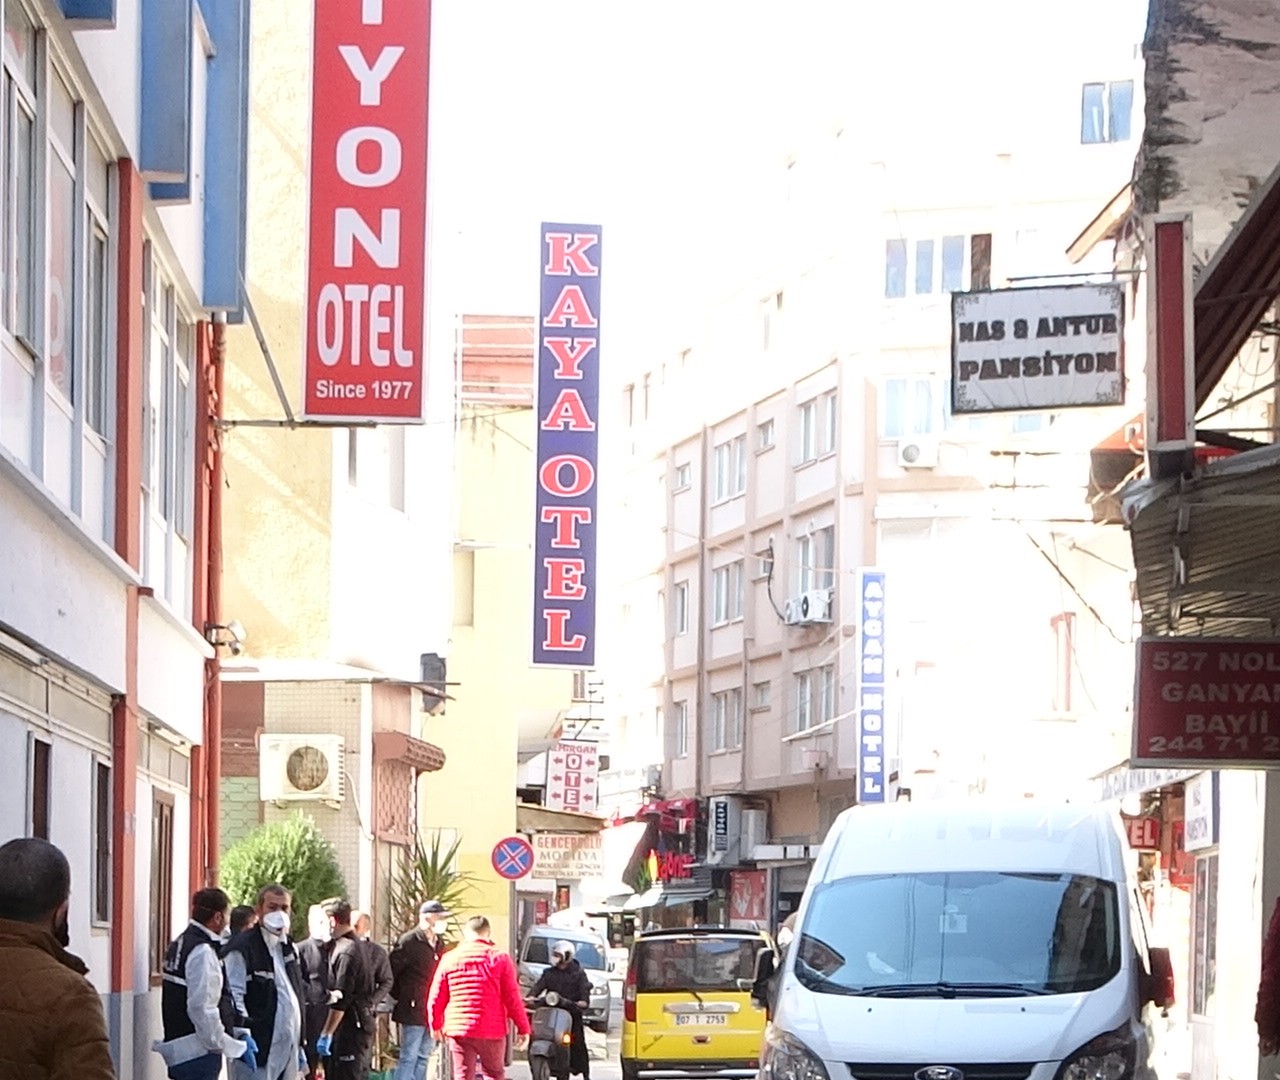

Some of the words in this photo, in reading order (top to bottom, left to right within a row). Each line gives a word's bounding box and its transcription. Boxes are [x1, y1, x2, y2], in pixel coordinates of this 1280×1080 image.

[316, 282, 414, 369] OTEL
[541, 233, 598, 431] KAYA
[1035, 312, 1118, 339] ANTUR
[959, 349, 1118, 382] PANSİYON
[316, 380, 366, 400] Since
[371, 381, 413, 400] 1977
[539, 454, 594, 652] OTEL
[1152, 651, 1208, 672] 527
[863, 693, 883, 793] HOTEL
[1148, 736, 1204, 753] 244
[1216, 736, 1250, 753] 71
